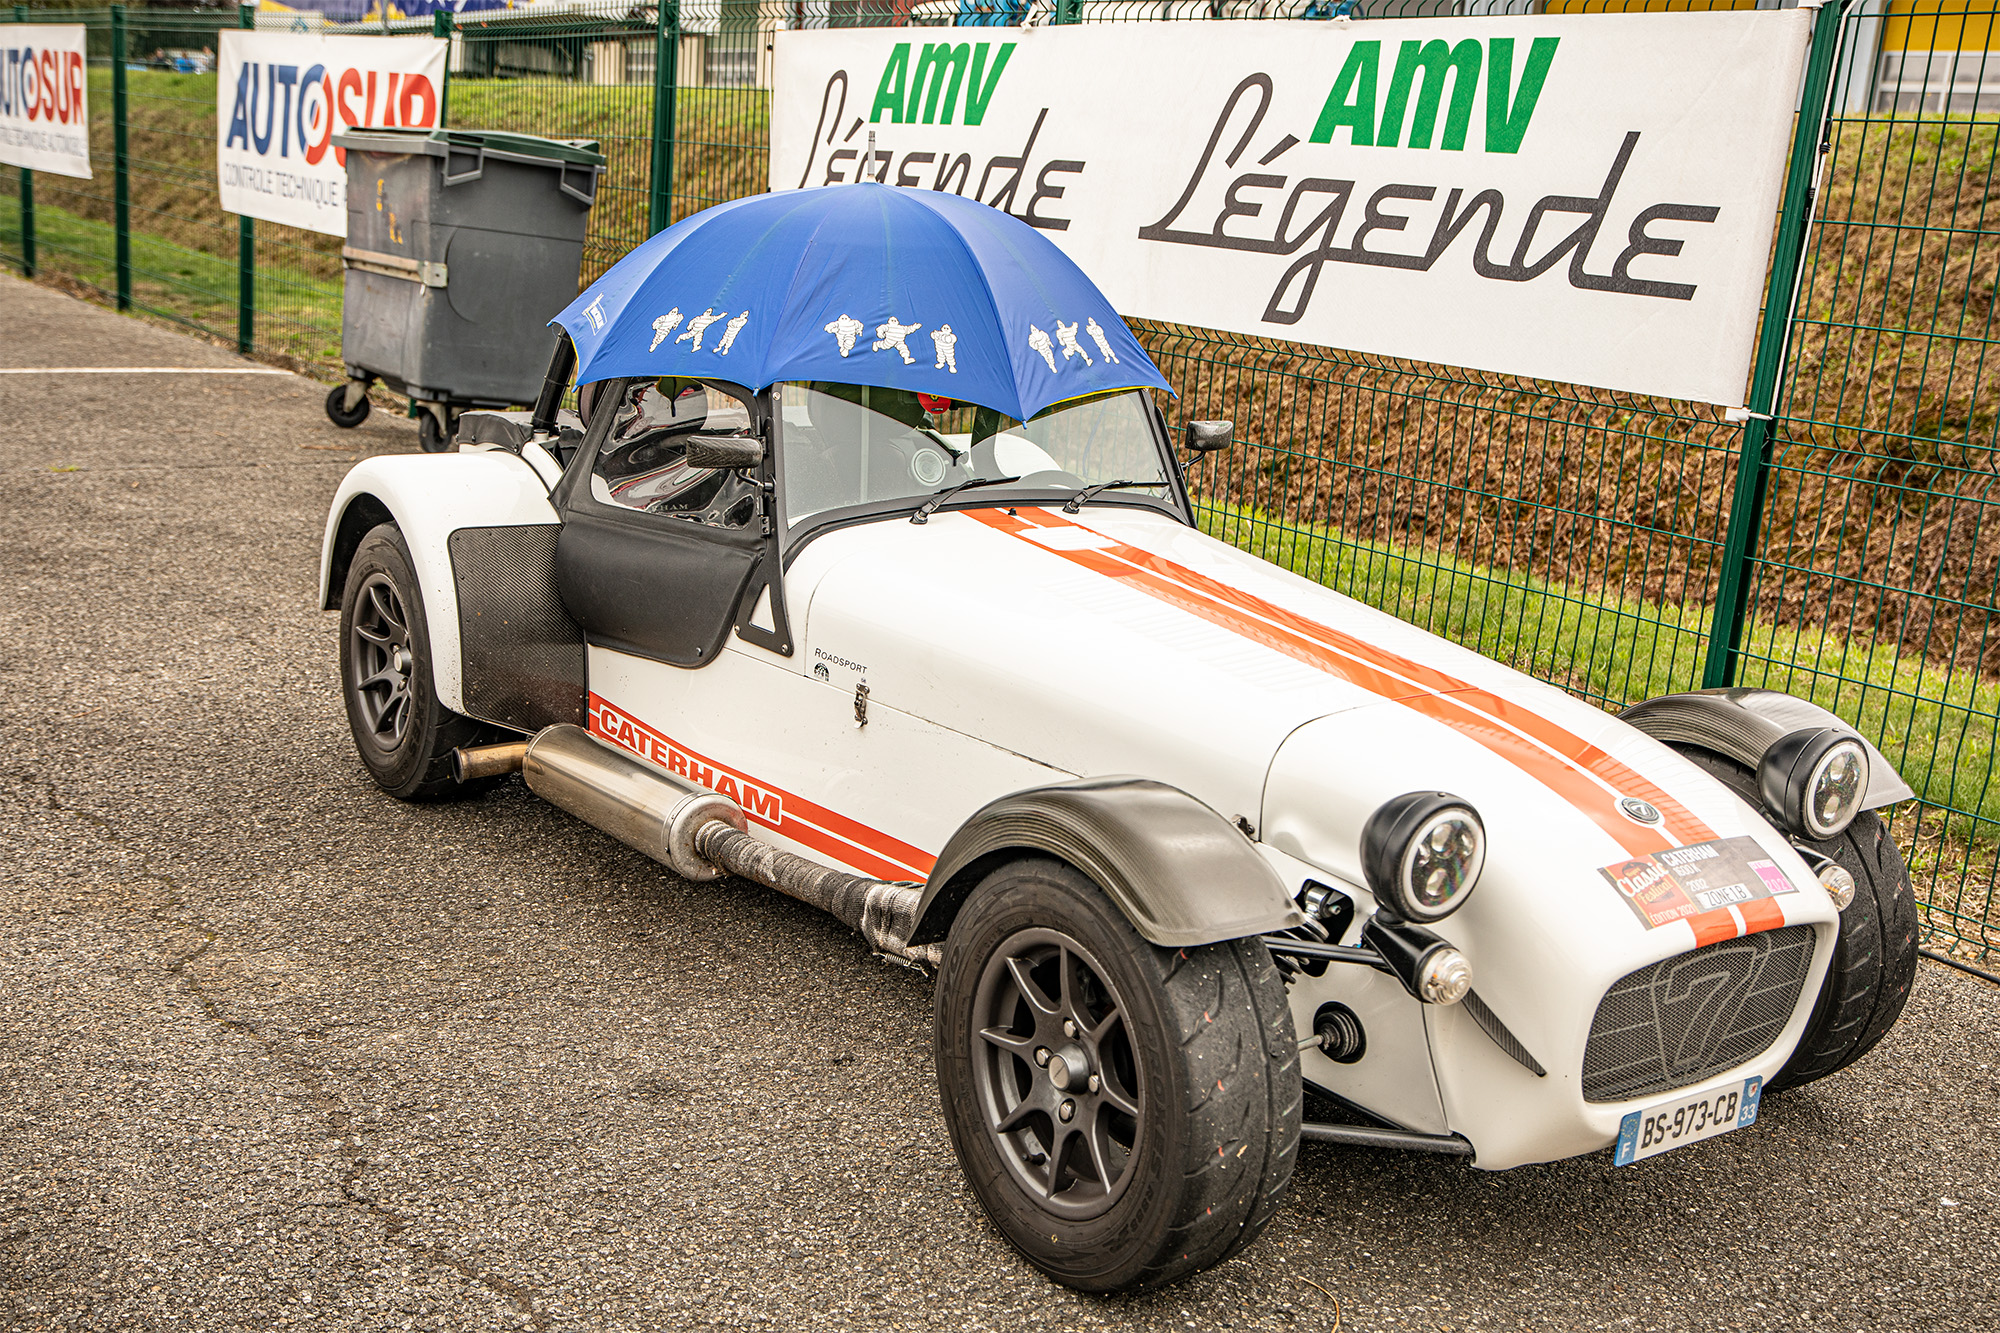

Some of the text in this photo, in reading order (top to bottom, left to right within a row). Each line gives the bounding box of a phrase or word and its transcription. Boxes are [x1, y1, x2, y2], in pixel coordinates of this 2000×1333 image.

[0, 46, 85, 126] UTOSUR
[869, 41, 1017, 126] AMV
[1309, 36, 1561, 154] AMV
[275, 171, 339, 209] TECHNIQUE
[1138, 72, 1721, 326] Légende
[814, 647, 868, 674] ROADSPORT
[600, 707, 782, 824] CATERHAM
[1660, 844, 1720, 867] CATERHAM
[1616, 862, 1670, 898] Classic
[1636, 877, 1674, 905] Festival
[1686, 877, 1710, 891] 2002
[1704, 887, 1734, 907] ZONE
[1649, 903, 1697, 925] ÉDITION 2021
[1640, 1091, 1738, 1150] BS-973-CB
[1740, 1102, 1756, 1122] 33
[1621, 1141, 1631, 1159] F
